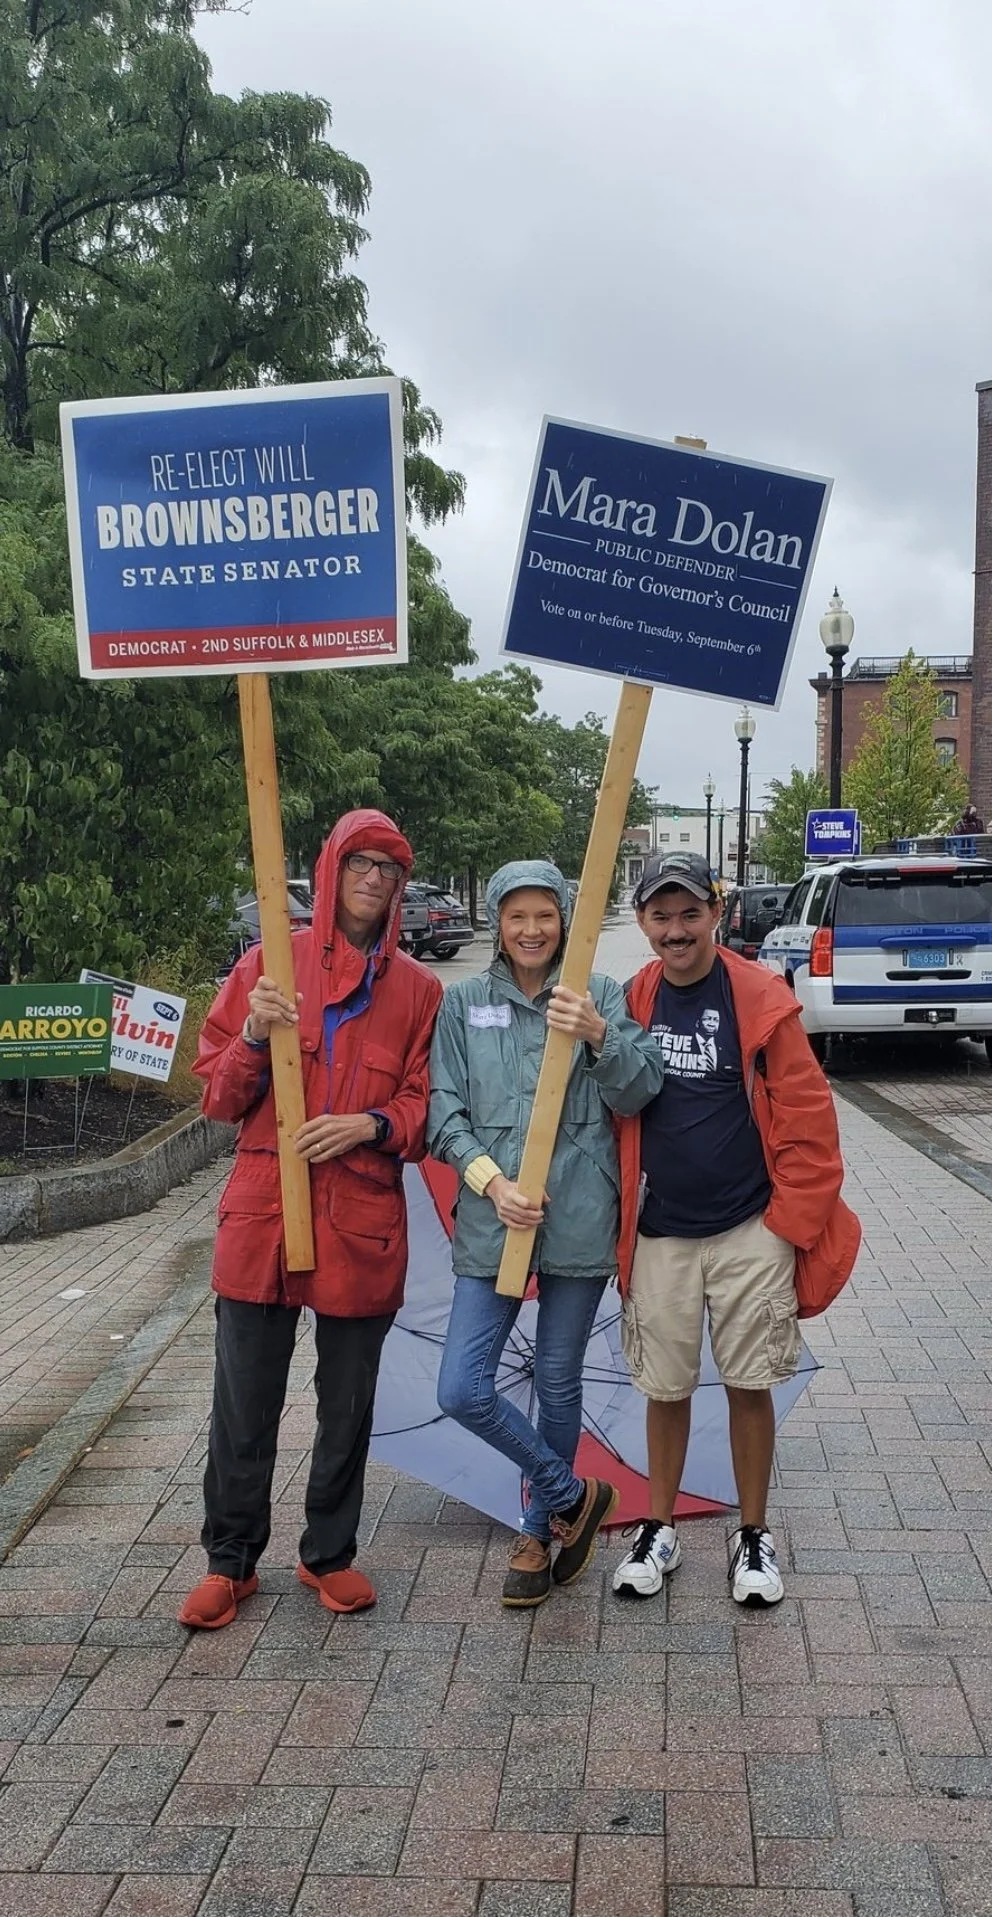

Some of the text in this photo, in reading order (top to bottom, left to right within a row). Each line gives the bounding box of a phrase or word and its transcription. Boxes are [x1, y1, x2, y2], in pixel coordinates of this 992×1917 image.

[150, 443, 315, 492] RE-ELECT WILL
[96, 487, 380, 550] BROWNSBERGER
[537, 467, 803, 570] Mara Dolan
[122, 555, 362, 588] STATE SENATOR
[594, 538, 736, 581] PUBLIC DEFENDER
[527, 551, 607, 583] Democrat
[612, 568, 635, 589] for
[728, 595, 792, 623] Council
[108, 640, 187, 657] DEMOCRAT
[201, 638, 229, 654] 2ND
[233, 635, 296, 652] SUFFOLK
[299, 634, 309, 648] &
[312, 628, 385, 647] MIDDLESEX
[540, 599, 565, 617] Vote
[567, 607, 582, 620] on
[584, 611, 597, 622] or
[598, 612, 634, 631] before
[636, 620, 684, 643] Tuesday,
[686, 631, 745, 656] September
[814, 829, 852, 839] TOMPKINS
[822, 821, 845, 830] STEVE
[944, 926, 990, 935] POLICE
[25, 1005, 83, 1018] RICARDO
[156, 1003, 173, 1018] SEPT
[0, 1017, 108, 1040] ARROYO
[111, 1013, 175, 1049] lvin
[125, 1050, 139, 1062] OF
[139, 1053, 169, 1071] STATE
